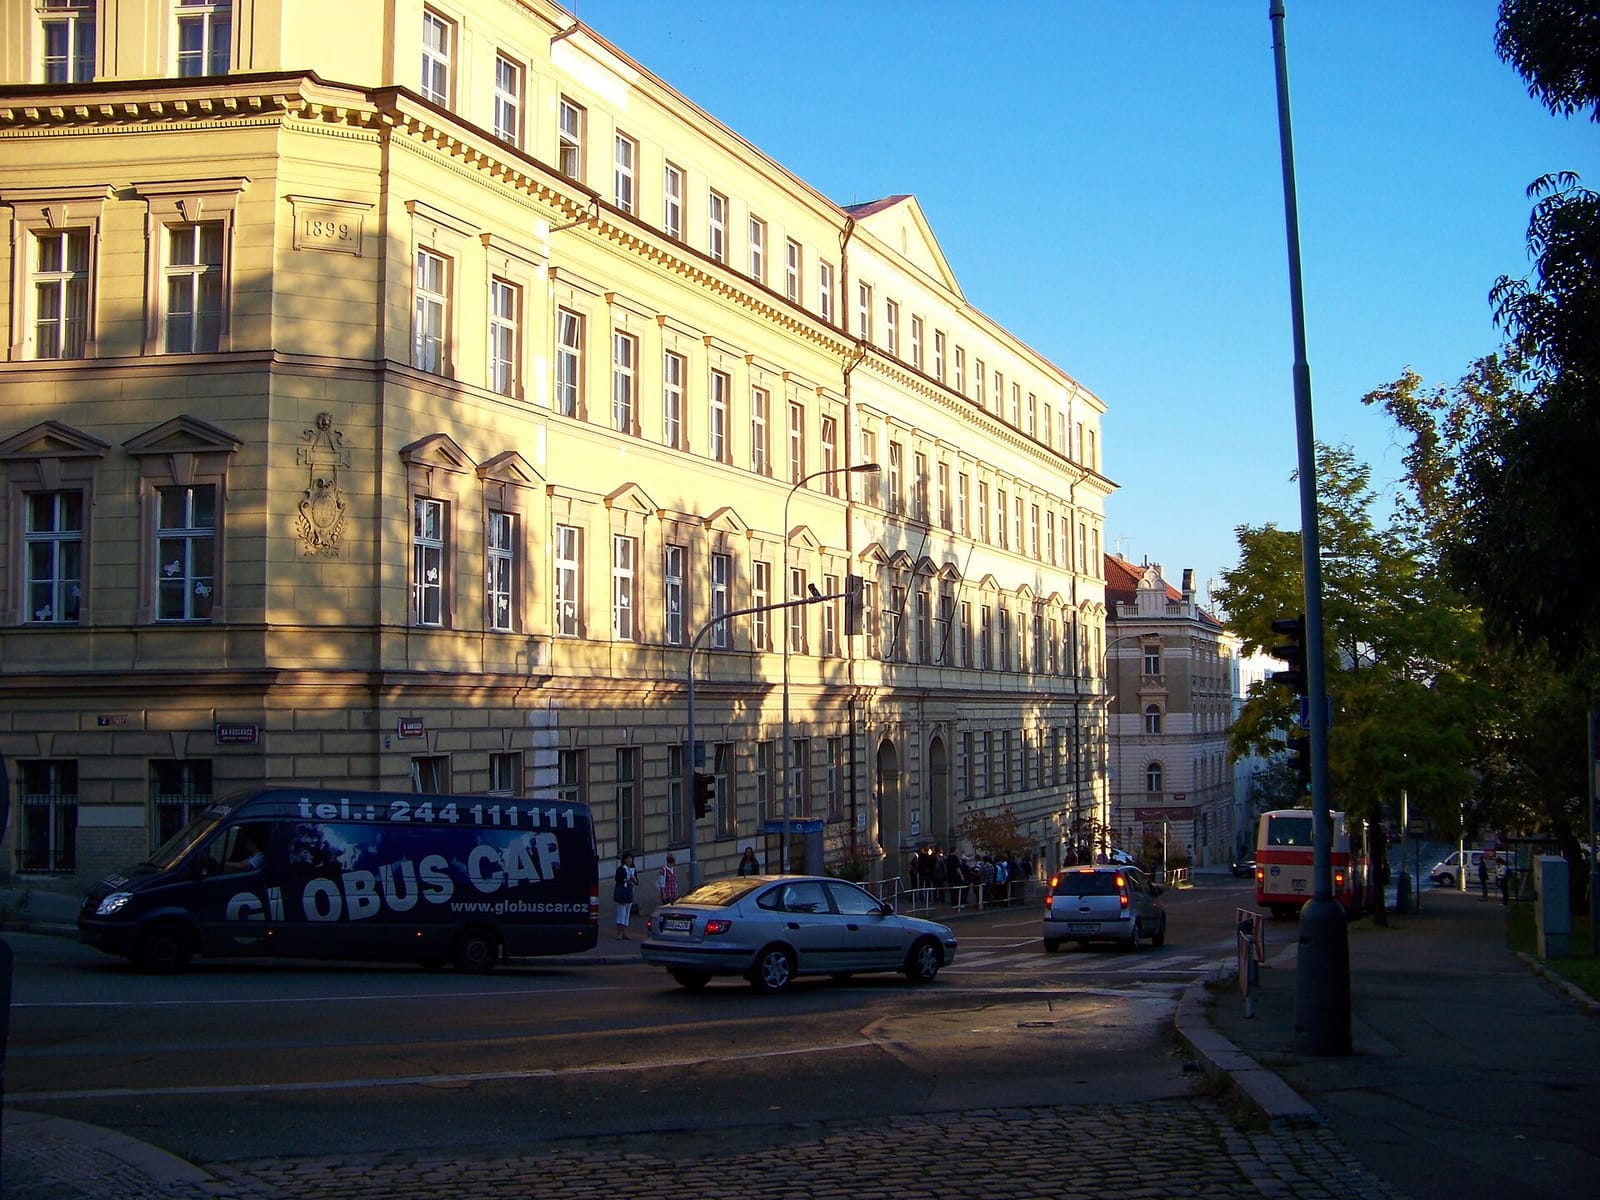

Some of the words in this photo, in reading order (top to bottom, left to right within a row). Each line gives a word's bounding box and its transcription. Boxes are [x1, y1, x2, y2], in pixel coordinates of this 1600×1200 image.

[305, 219, 352, 241] 1899.
[297, 797, 376, 821] tel.:
[390, 800, 459, 825] 244
[469, 804, 519, 827] 111
[527, 807, 575, 830] 111
[450, 899, 589, 915] www.globuscar.cz
